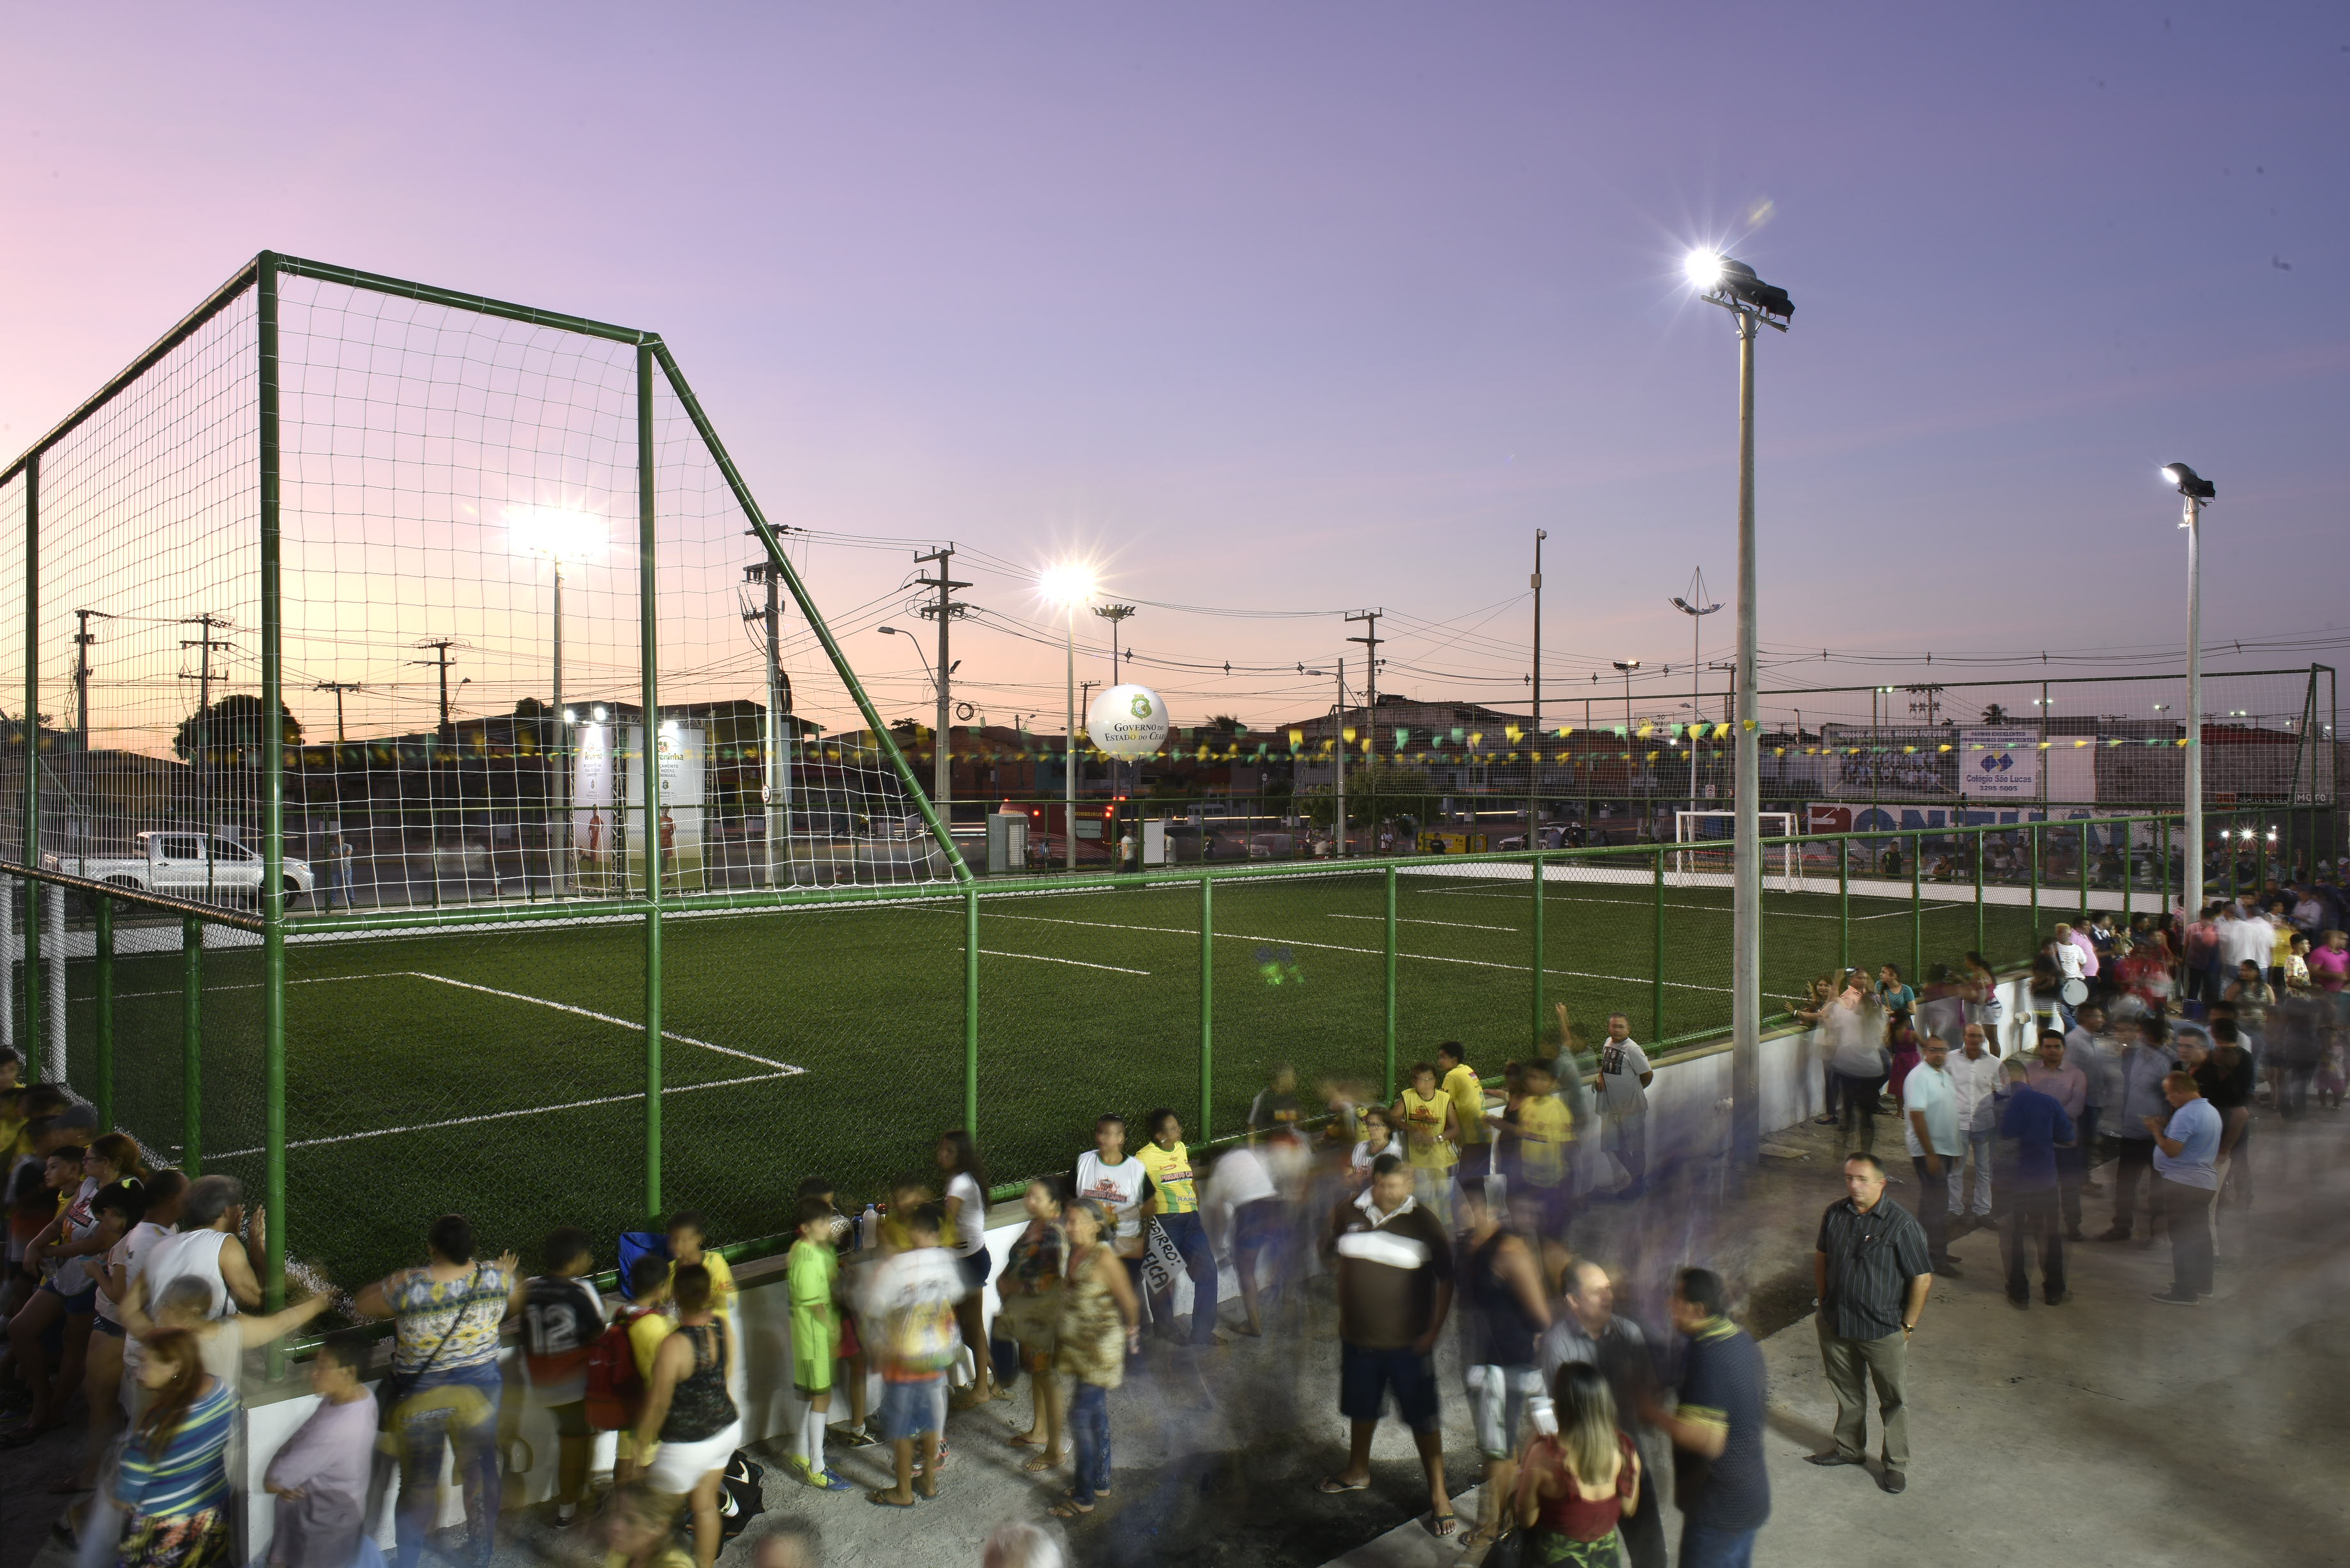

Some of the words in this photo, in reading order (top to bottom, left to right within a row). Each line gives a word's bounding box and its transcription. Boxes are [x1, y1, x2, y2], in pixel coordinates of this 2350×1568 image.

[1114, 723, 1156, 732] GOVERNO
[1104, 732, 1136, 741] ESTADO
[659, 753, 685, 761] eninha
[1966, 774, 1993, 785] Colégio
[1994, 774, 2008, 783] São
[2010, 774, 2033, 783] Lucas
[1142, 1249, 1169, 1289] FICA
[526, 1303, 580, 1353] 12
